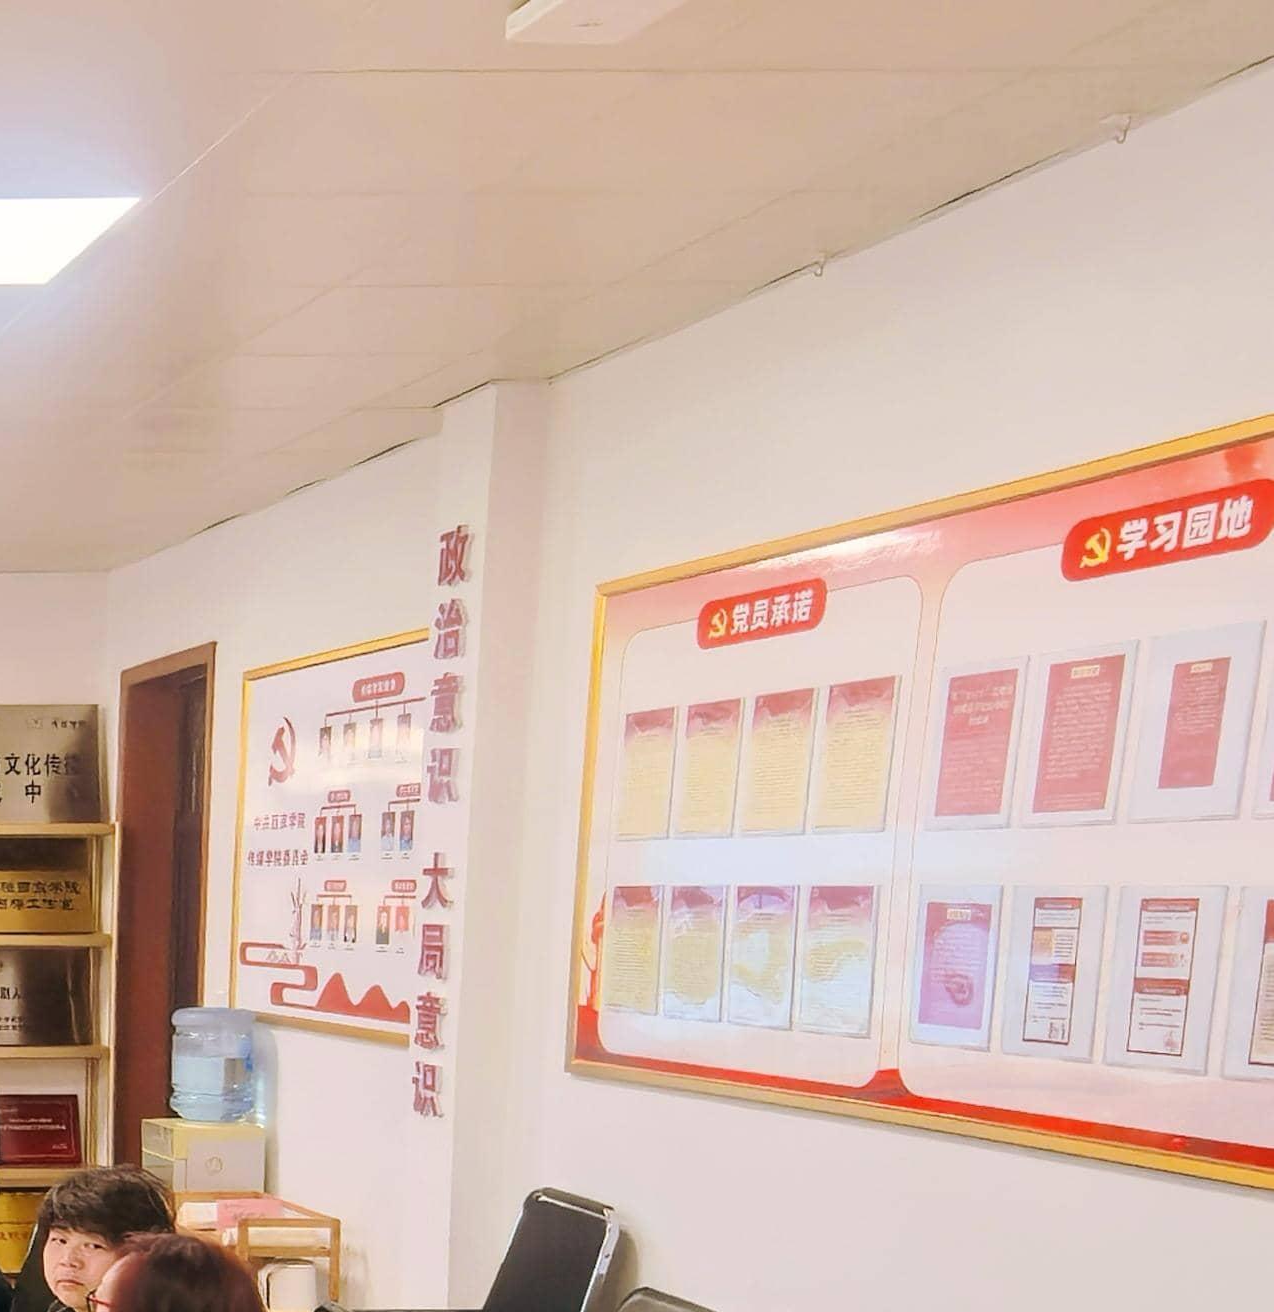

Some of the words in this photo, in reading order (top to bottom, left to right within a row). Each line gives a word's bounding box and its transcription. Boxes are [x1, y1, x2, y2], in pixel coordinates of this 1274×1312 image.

[730, 588, 814, 636] 党员承诺
[1116, 494, 1254, 562] 学习园地
[426, 524, 471, 804] 政治意识
[411, 852, 452, 1120] 大局意识
